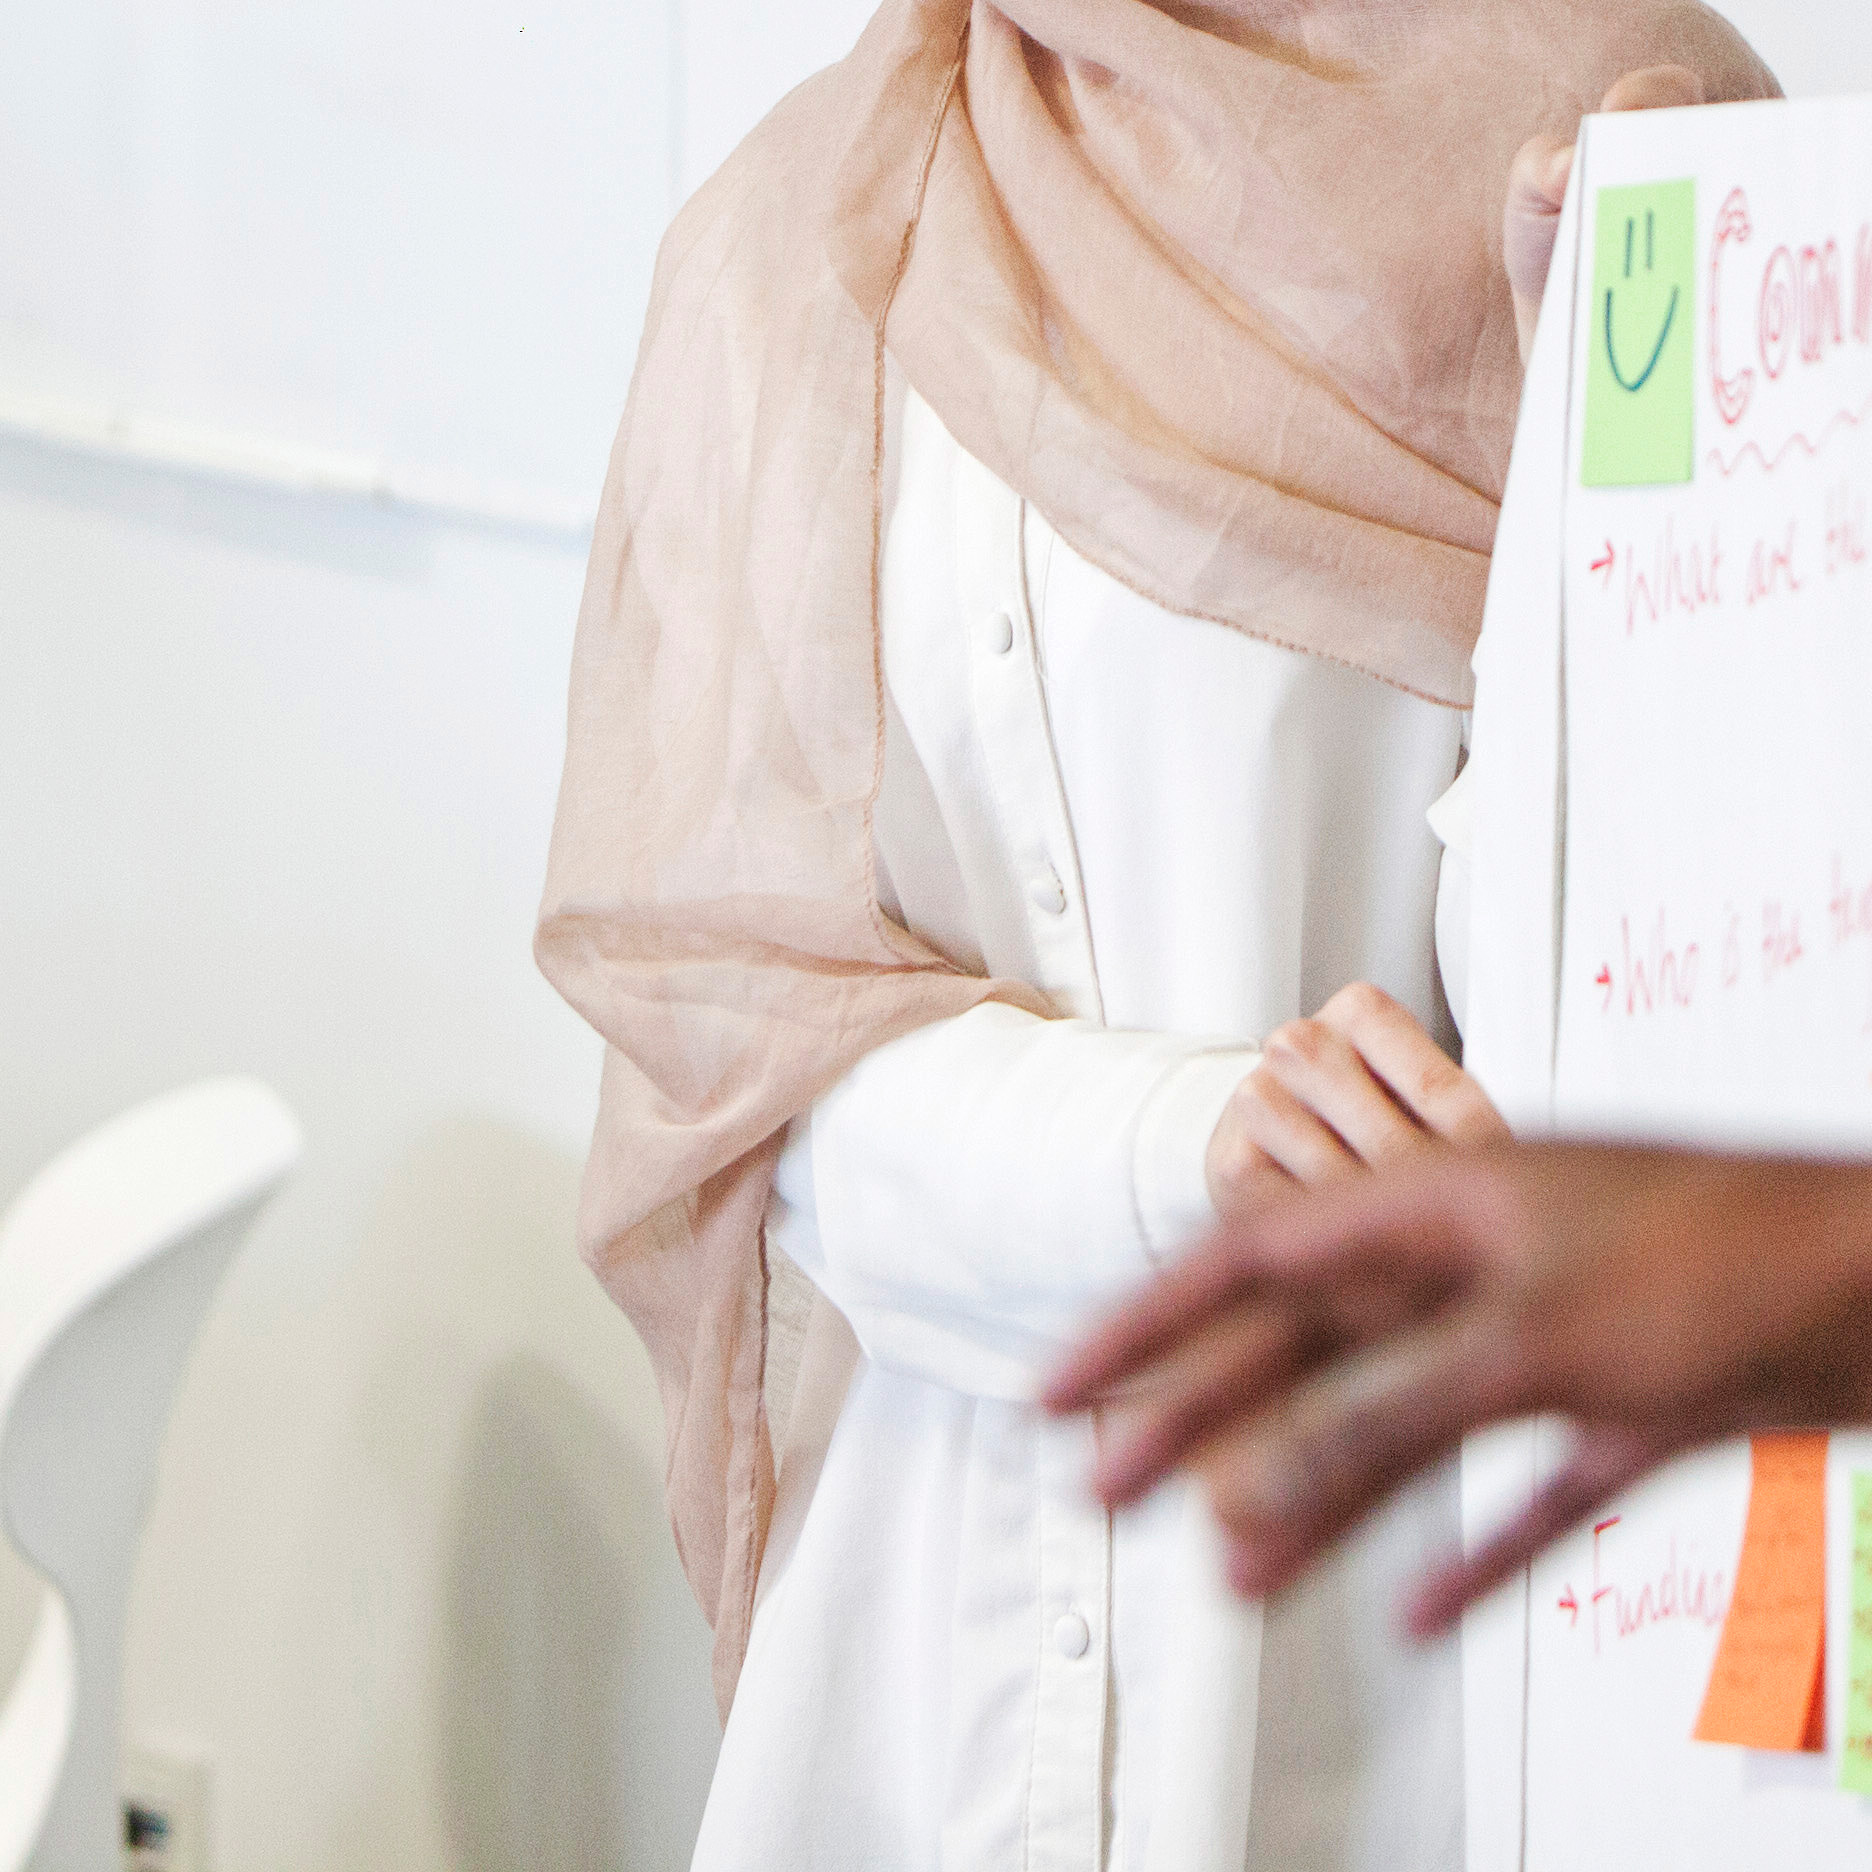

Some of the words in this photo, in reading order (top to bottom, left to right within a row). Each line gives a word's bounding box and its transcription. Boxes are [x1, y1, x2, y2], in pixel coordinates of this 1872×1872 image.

[1623, 512, 1724, 637] What
[1744, 516, 1805, 607] are
[1619, 902, 1702, 1019] Who
